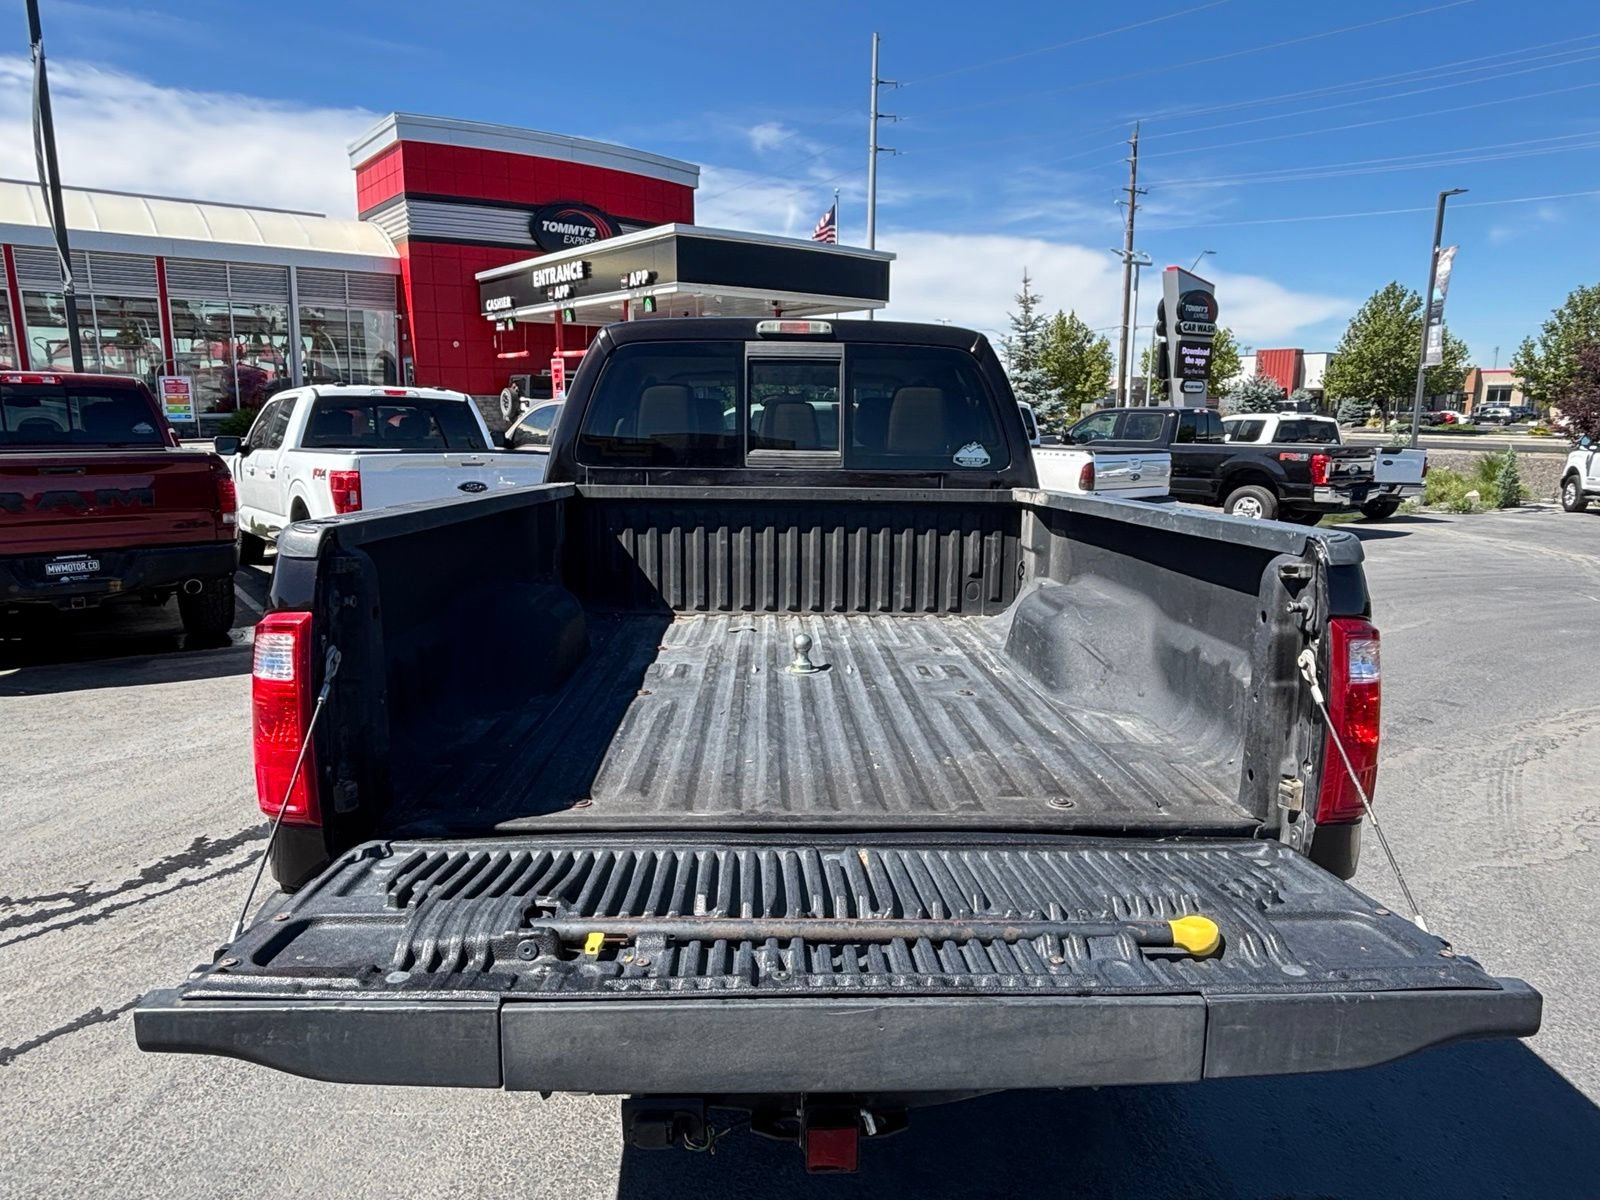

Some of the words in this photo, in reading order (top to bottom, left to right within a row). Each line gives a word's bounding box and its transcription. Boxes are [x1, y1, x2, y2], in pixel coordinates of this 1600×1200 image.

[542, 220, 597, 238] TOMMY'S
[563, 235, 599, 245] EXPRES
[533, 261, 583, 287] ENTRANCE
[629, 269, 649, 287] APP
[554, 284, 570, 300] APP
[486, 296, 511, 311] CASHIER
[1185, 304, 1208, 313] TOMMY'S
[1183, 322, 1197, 331] CAR
[1197, 323, 1215, 333] WASH
[1182, 347, 1210, 356] Download
[1185, 356, 1194, 365] the
[1195, 357, 1206, 367] app
[47, 561, 98, 573] MWMOTOR.CO
